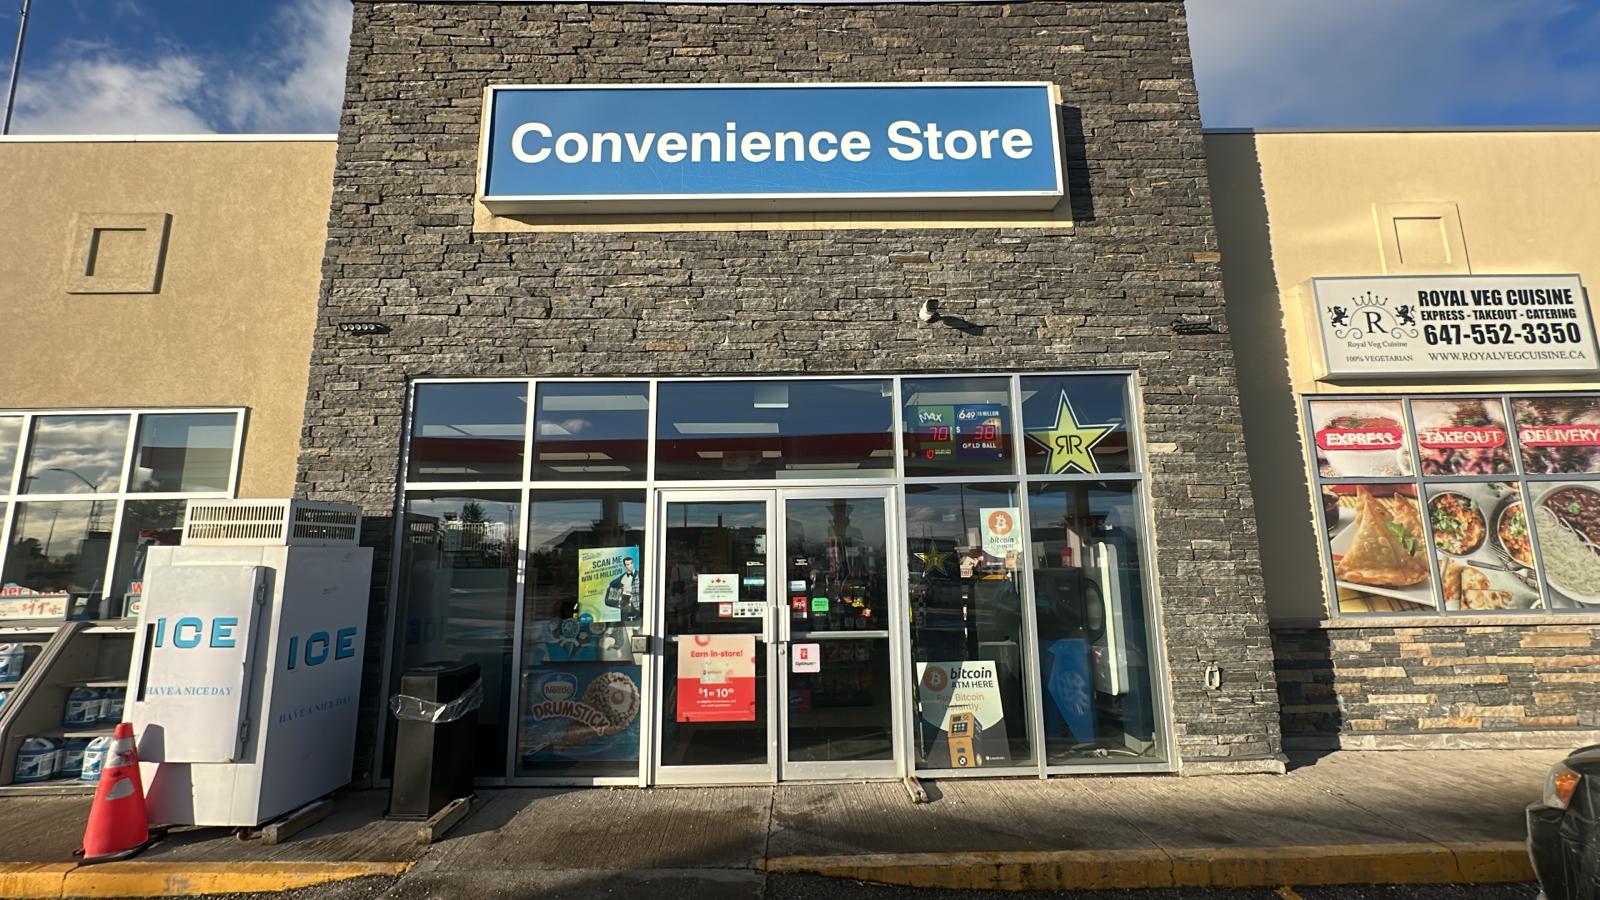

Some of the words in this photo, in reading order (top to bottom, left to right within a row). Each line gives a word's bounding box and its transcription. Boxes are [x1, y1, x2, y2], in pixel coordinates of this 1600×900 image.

[511, 122, 872, 164] Convenience
[887, 120, 1034, 161] Store
[1417, 290, 1469, 307] ROYAL
[1471, 289, 1503, 306] VEG
[1506, 288, 1574, 306] CUISINE
[1420, 310, 1465, 321] EXPRESS
[1472, 309, 1517, 321] TAKEOUT
[1525, 308, 1577, 320] CATERING
[1363, 311, 1389, 334] R
[1423, 322, 1582, 346] 647-552-3350
[1347, 341, 1367, 349] Royal
[1368, 340, 1382, 348] Veg
[1428, 350, 1586, 361] WWW.ROYALVEGCUISINE.CA
[918, 412, 942, 423] MAX
[929, 426, 948, 440] 70
[975, 426, 994, 440] 38
[1325, 431, 1396, 446] EXPRESS
[1423, 430, 1500, 444] TAKEOUT
[1521, 428, 1600, 442] DELIVERY
[592, 558, 611, 568] SCAN
[612, 555, 622, 564] ME
[582, 574, 592, 583] WIN
[600, 568, 623, 580] MILLION
[155, 616, 239, 649] ICE
[287, 626, 358, 671] ICE
[711, 650, 743, 658] in-store!
[950, 667, 992, 679] bitcoin
[146, 687, 174, 696] HAVE
[175, 687, 182, 696] A
[184, 687, 211, 696] NICE
[212, 687, 232, 696] DAY
[955, 693, 984, 702] Bitcoin
[533, 702, 609, 734] DRUMSTICK
